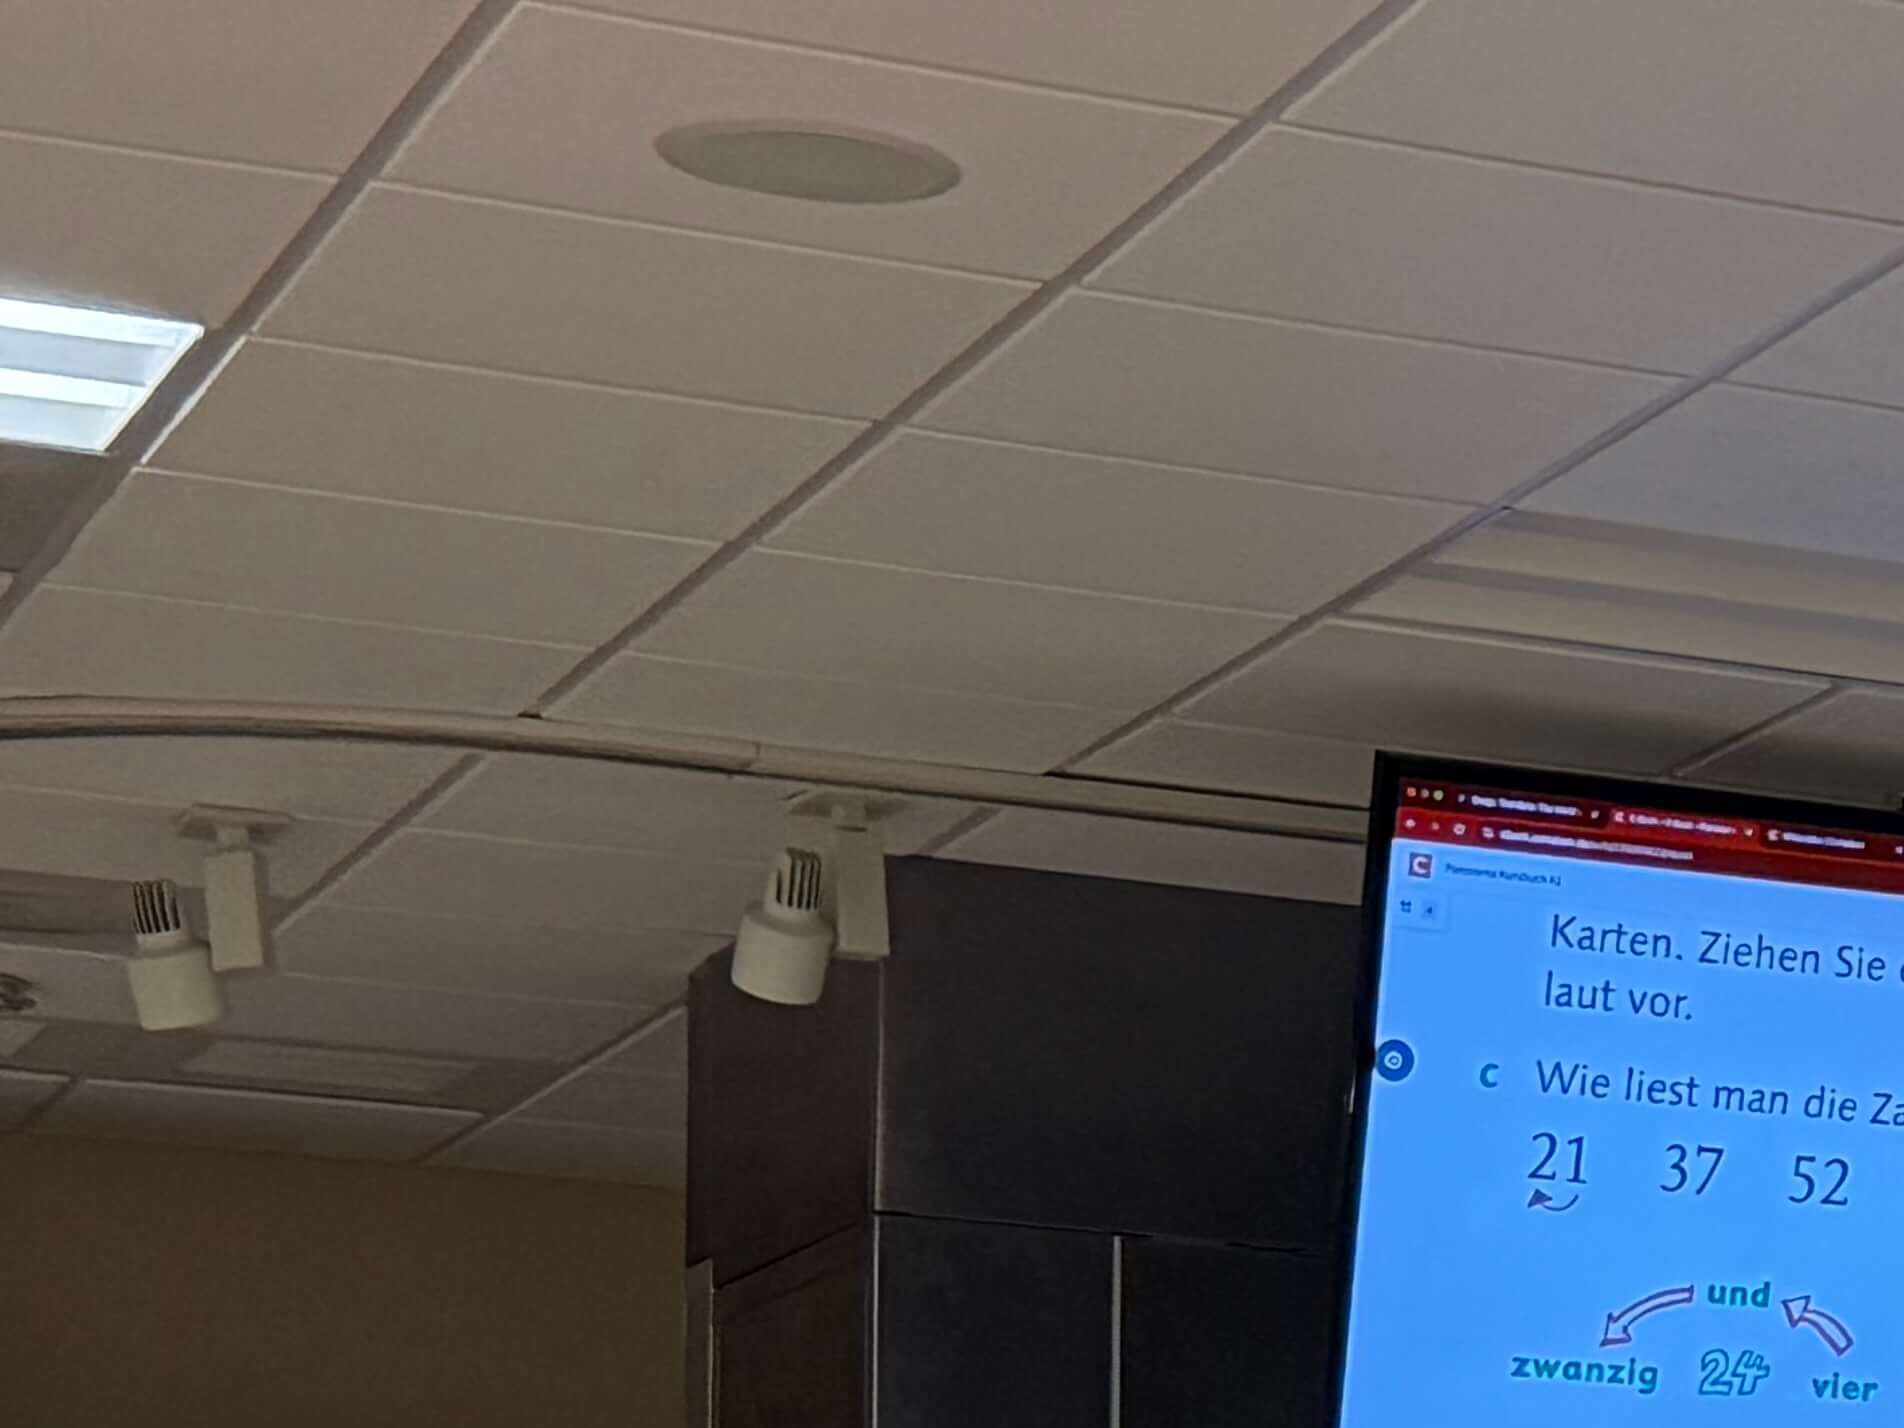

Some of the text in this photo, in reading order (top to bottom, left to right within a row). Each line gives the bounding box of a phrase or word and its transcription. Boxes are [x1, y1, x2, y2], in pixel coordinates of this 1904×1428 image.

[1550, 913, 1684, 961] Karten.
[1697, 930, 1820, 975] Ziehen
[1833, 945, 1887, 982] Sie
[1544, 969, 1693, 1021] laut vor.
[1535, 1058, 1611, 1099] Wie
[1624, 1066, 1701, 1108] liest
[1712, 1085, 1789, 1116] man
[1803, 1084, 1858, 1123] die
[1527, 1131, 1588, 1185] 21
[1659, 1143, 1725, 1196] 37
[1787, 1154, 1849, 1207] 52
[1707, 1280, 1772, 1309] und
[1510, 1347, 1879, 1403] zwanzig 24 vier
